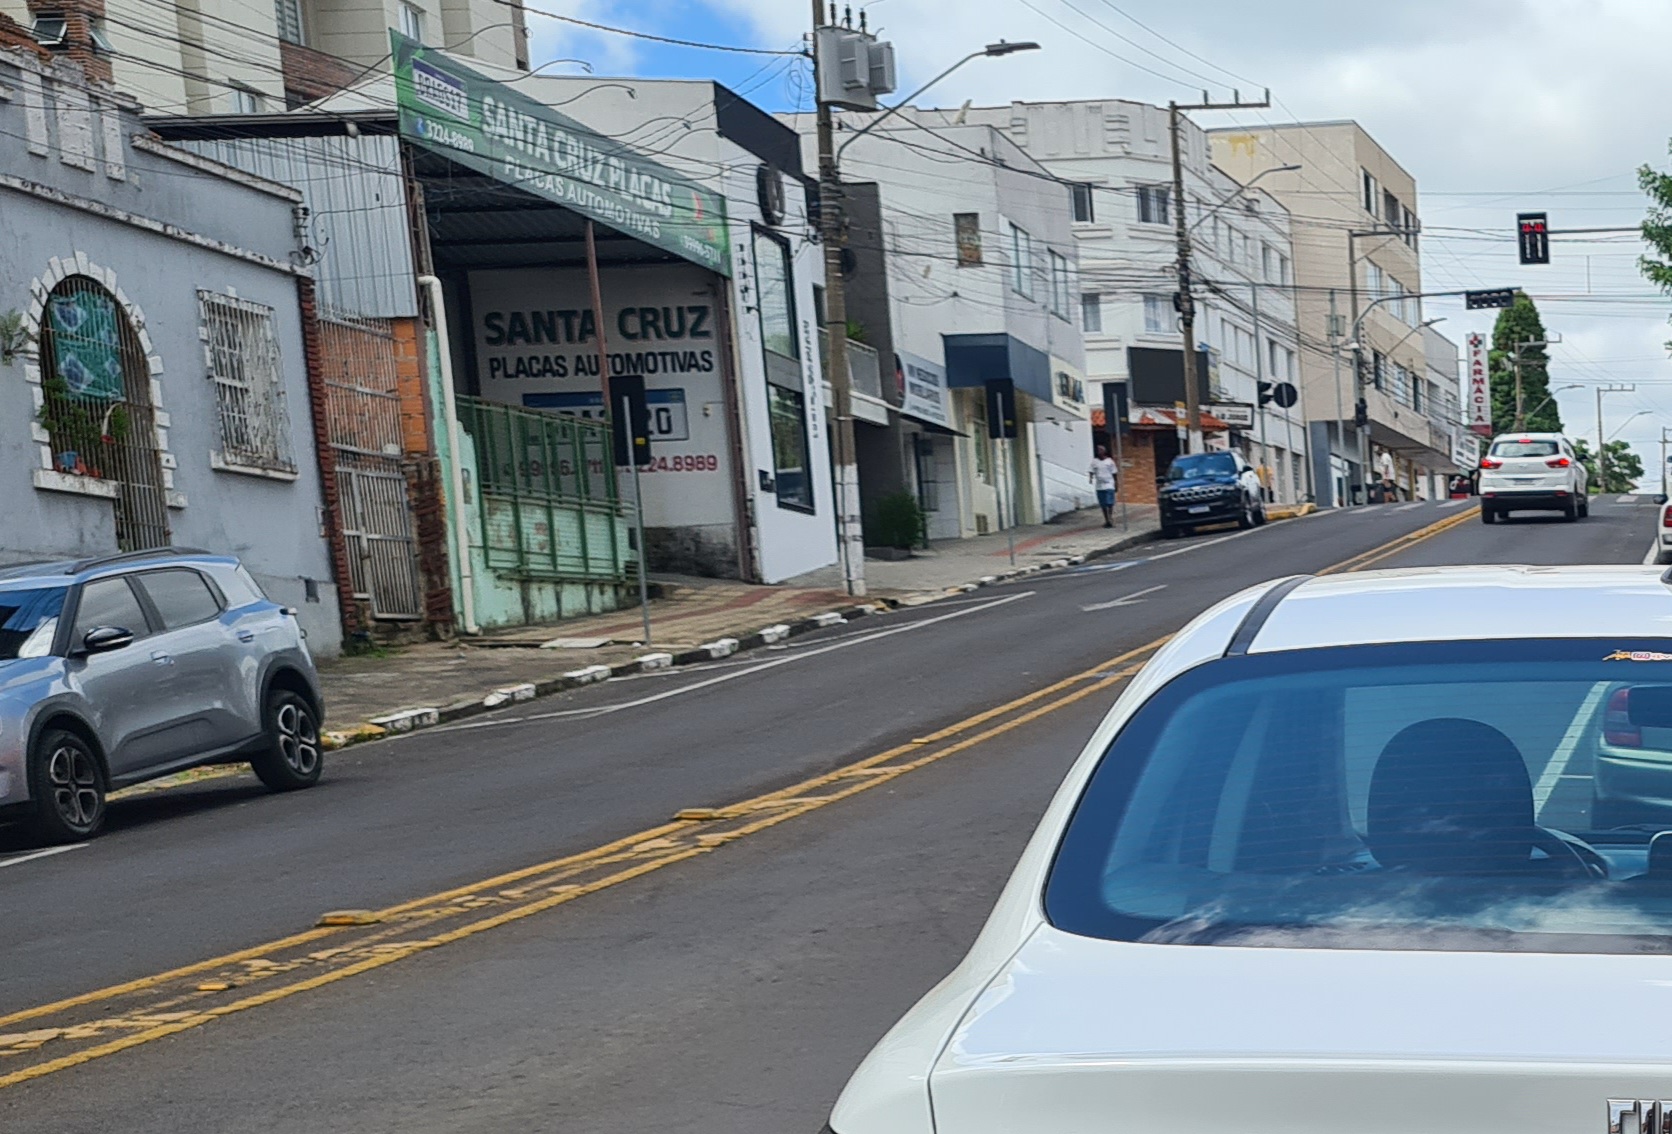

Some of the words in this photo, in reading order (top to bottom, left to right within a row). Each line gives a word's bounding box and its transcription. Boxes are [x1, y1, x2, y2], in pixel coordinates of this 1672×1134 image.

[482, 96, 550, 161] SANTA
[553, 131, 606, 187] CRUZ
[609, 157, 672, 218] PLACAS
[504, 155, 564, 197] PLACAS
[567, 183, 661, 239] AUTOMOTIVAS
[485, 309, 602, 346] SANTA
[618, 306, 713, 341] CRUZ
[489, 355, 568, 379] PLACAS
